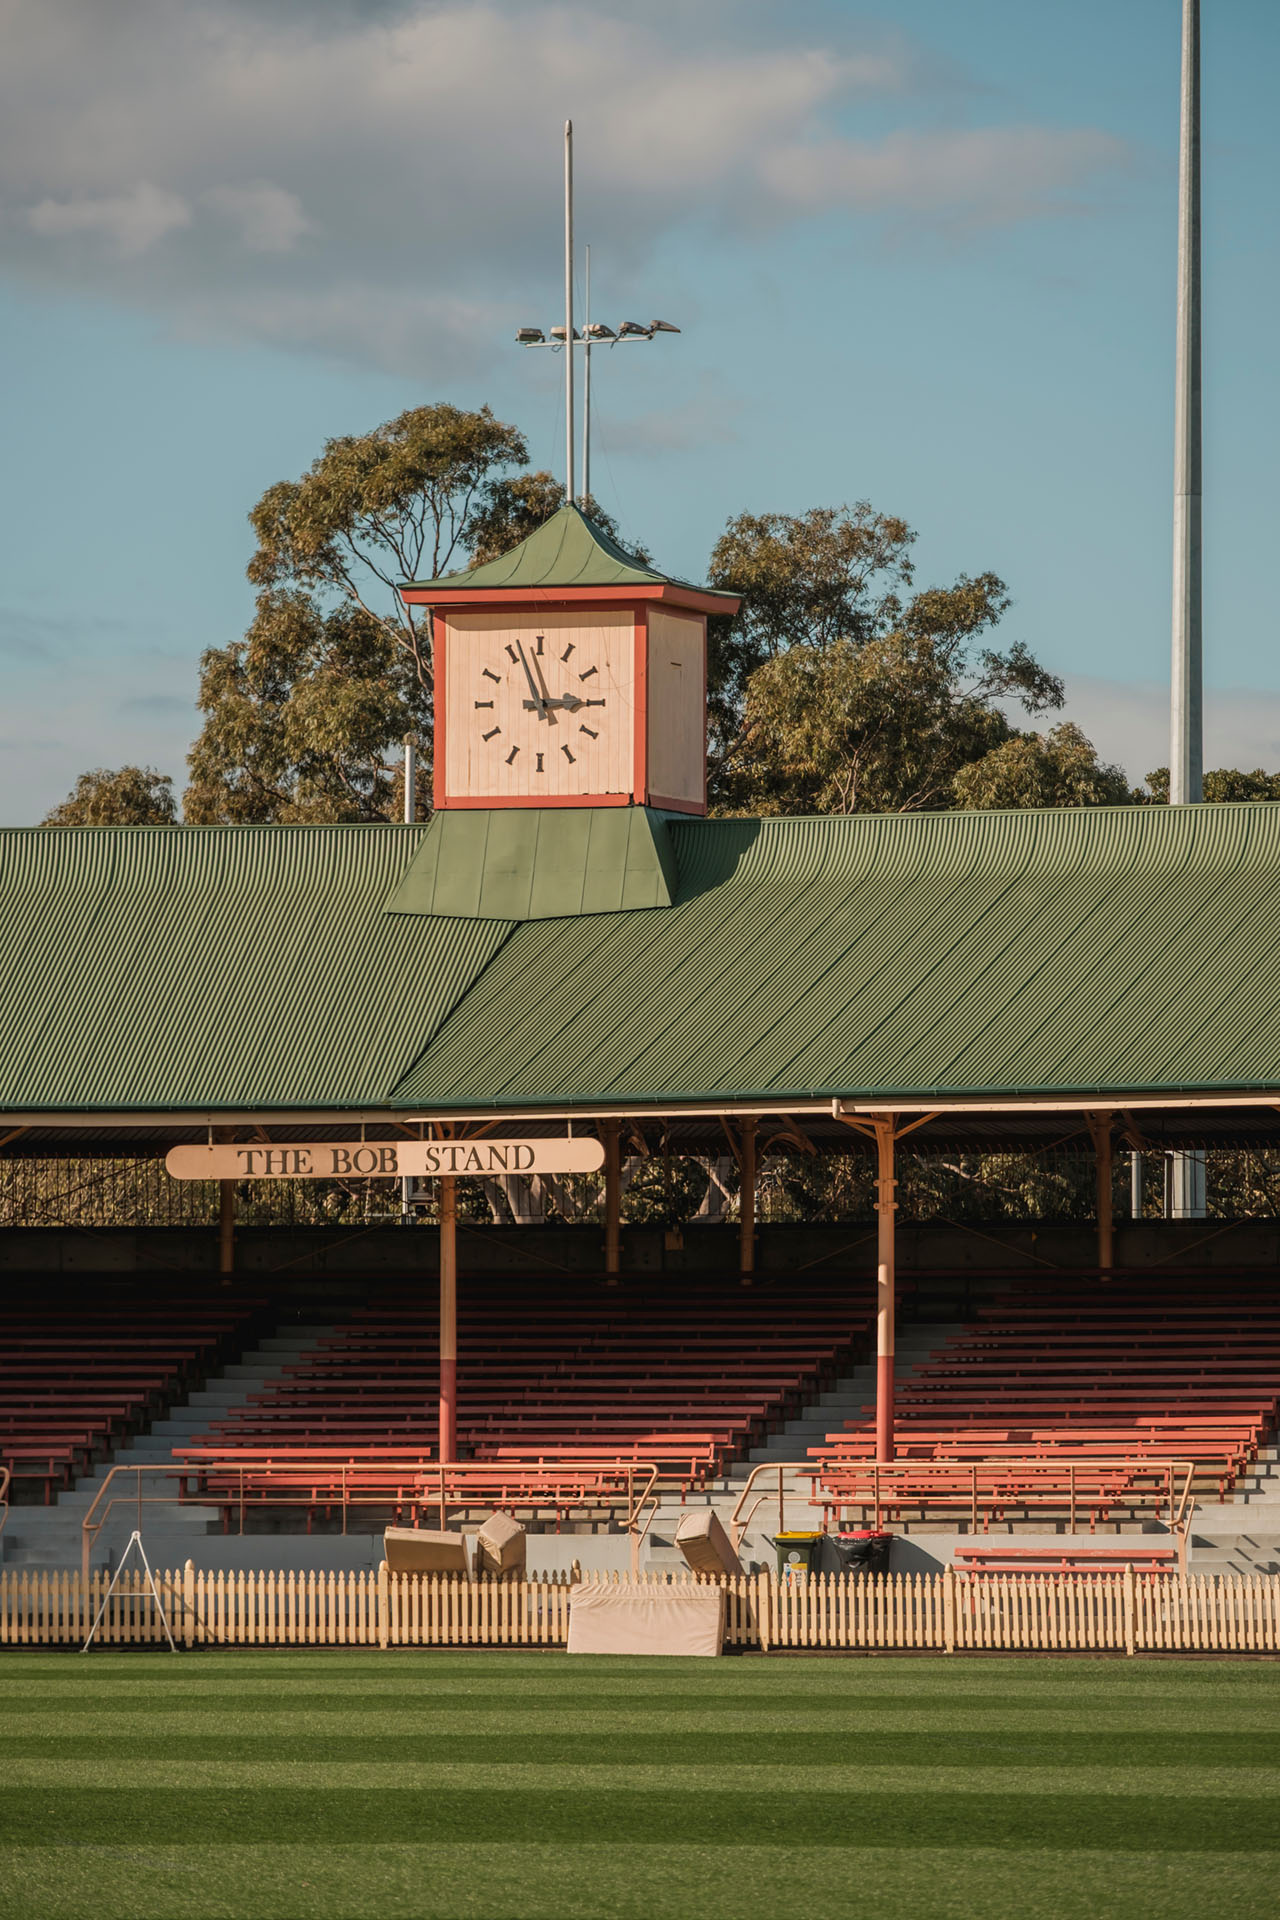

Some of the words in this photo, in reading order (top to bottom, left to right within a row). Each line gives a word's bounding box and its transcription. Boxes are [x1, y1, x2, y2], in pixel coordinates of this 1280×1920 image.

[237, 1150, 313, 1175] THE
[331, 1148, 398, 1174] BOB
[426, 1145, 535, 1173] STAND
